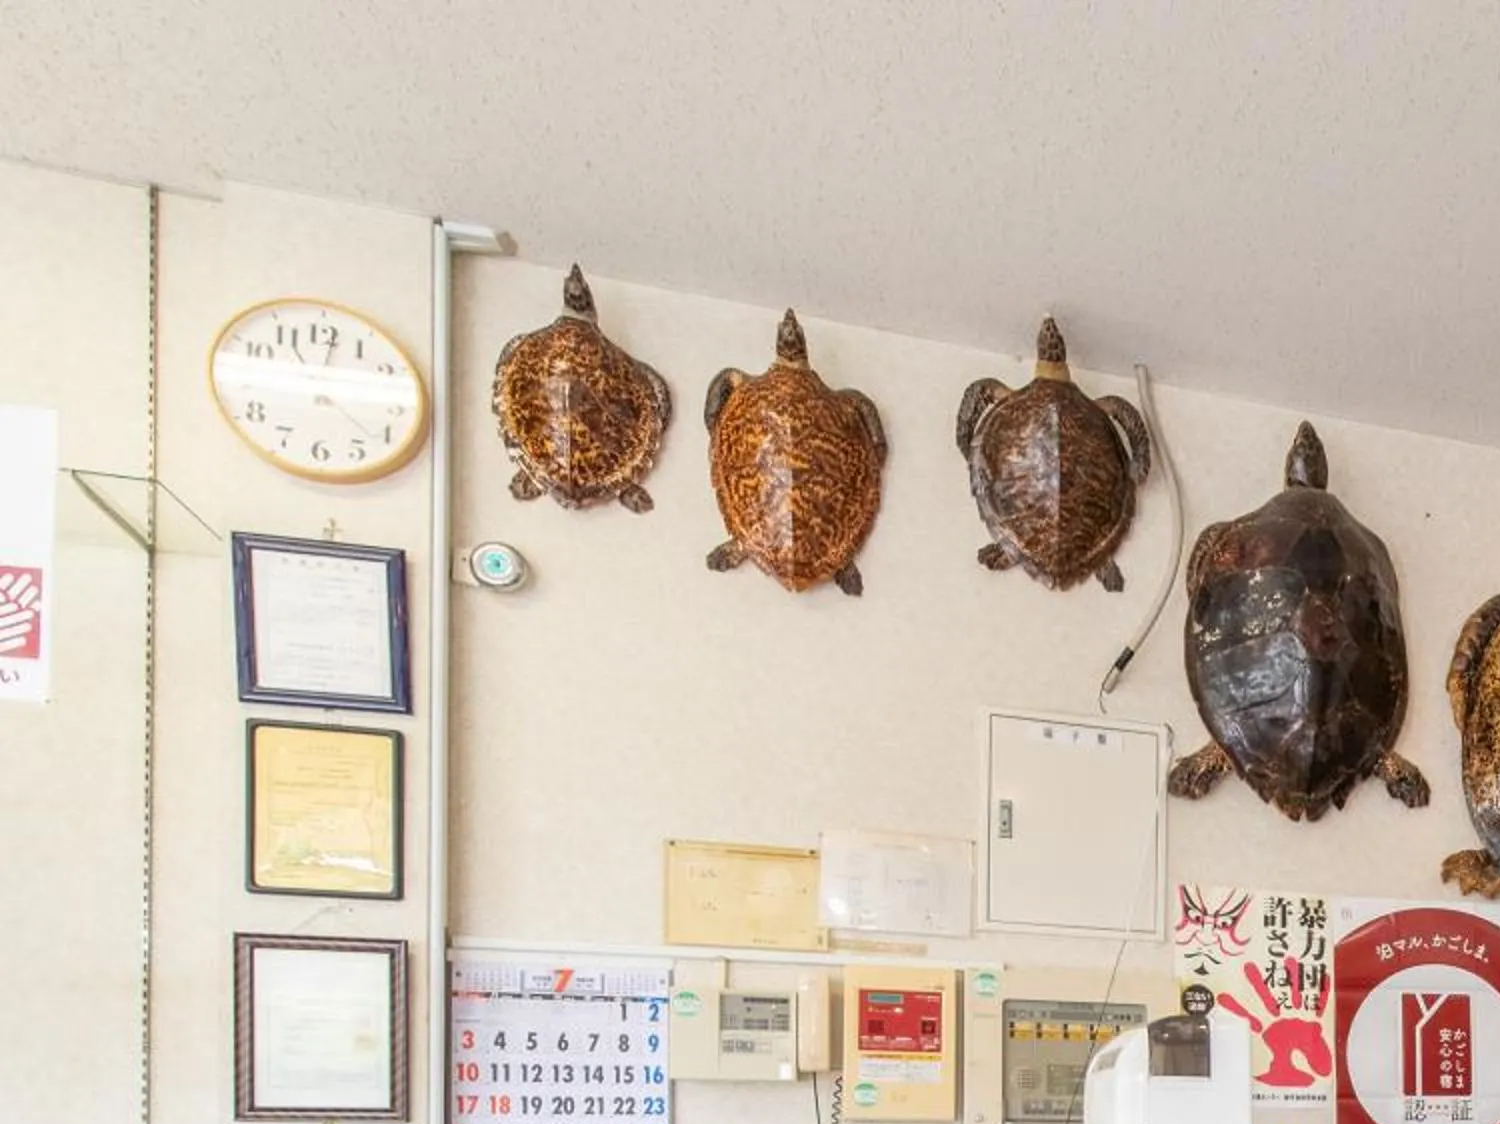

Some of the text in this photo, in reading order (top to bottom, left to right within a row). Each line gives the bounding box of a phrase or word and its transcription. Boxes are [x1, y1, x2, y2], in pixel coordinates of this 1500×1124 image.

[277, 324, 298, 347] 11
[310, 323, 339, 348] 12
[356, 339, 363, 360] 1
[245, 400, 266, 423] 8
[275, 424, 294, 448] 7
[311, 440, 330, 462] 6
[349, 438, 366, 461] 5
[554, 969, 575, 993] 7
[620, 1003, 659, 1022] 1 2
[462, 1030, 658, 1052] 3 4 5 6 7 8 9
[1454, 1027, 1467, 1089] かごしま
[456, 1063, 664, 1084] 10 11 12 13 14 15 16
[456, 1095, 664, 1115] 17 18 19 20 21 22 23
